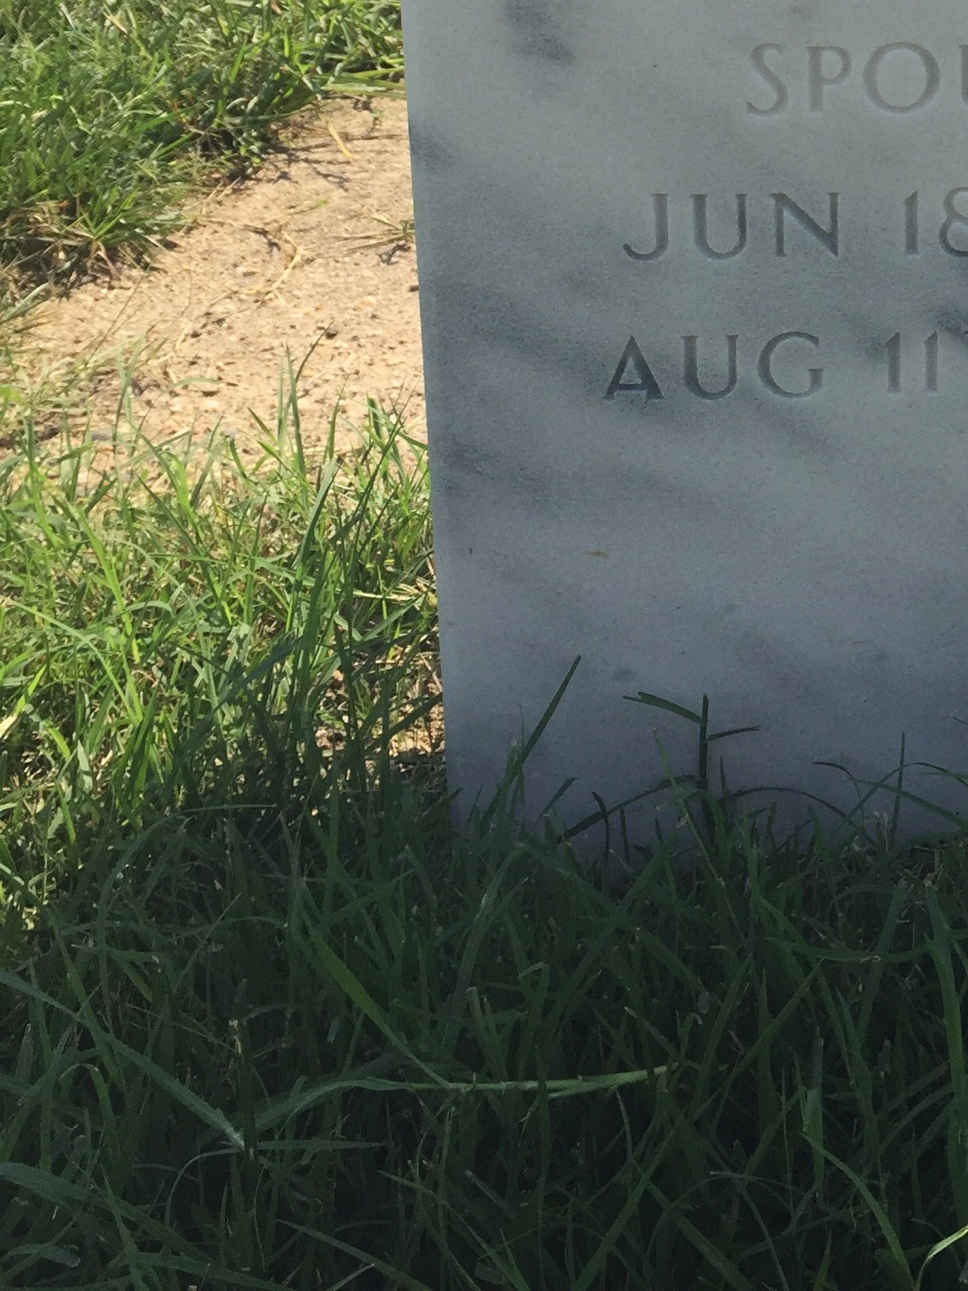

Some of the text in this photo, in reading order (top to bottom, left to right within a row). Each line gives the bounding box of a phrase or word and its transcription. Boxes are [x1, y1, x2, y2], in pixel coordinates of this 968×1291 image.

[623, 190, 840, 261] JUN
[602, 331, 825, 400] AUG
[886, 330, 940, 395] 11
